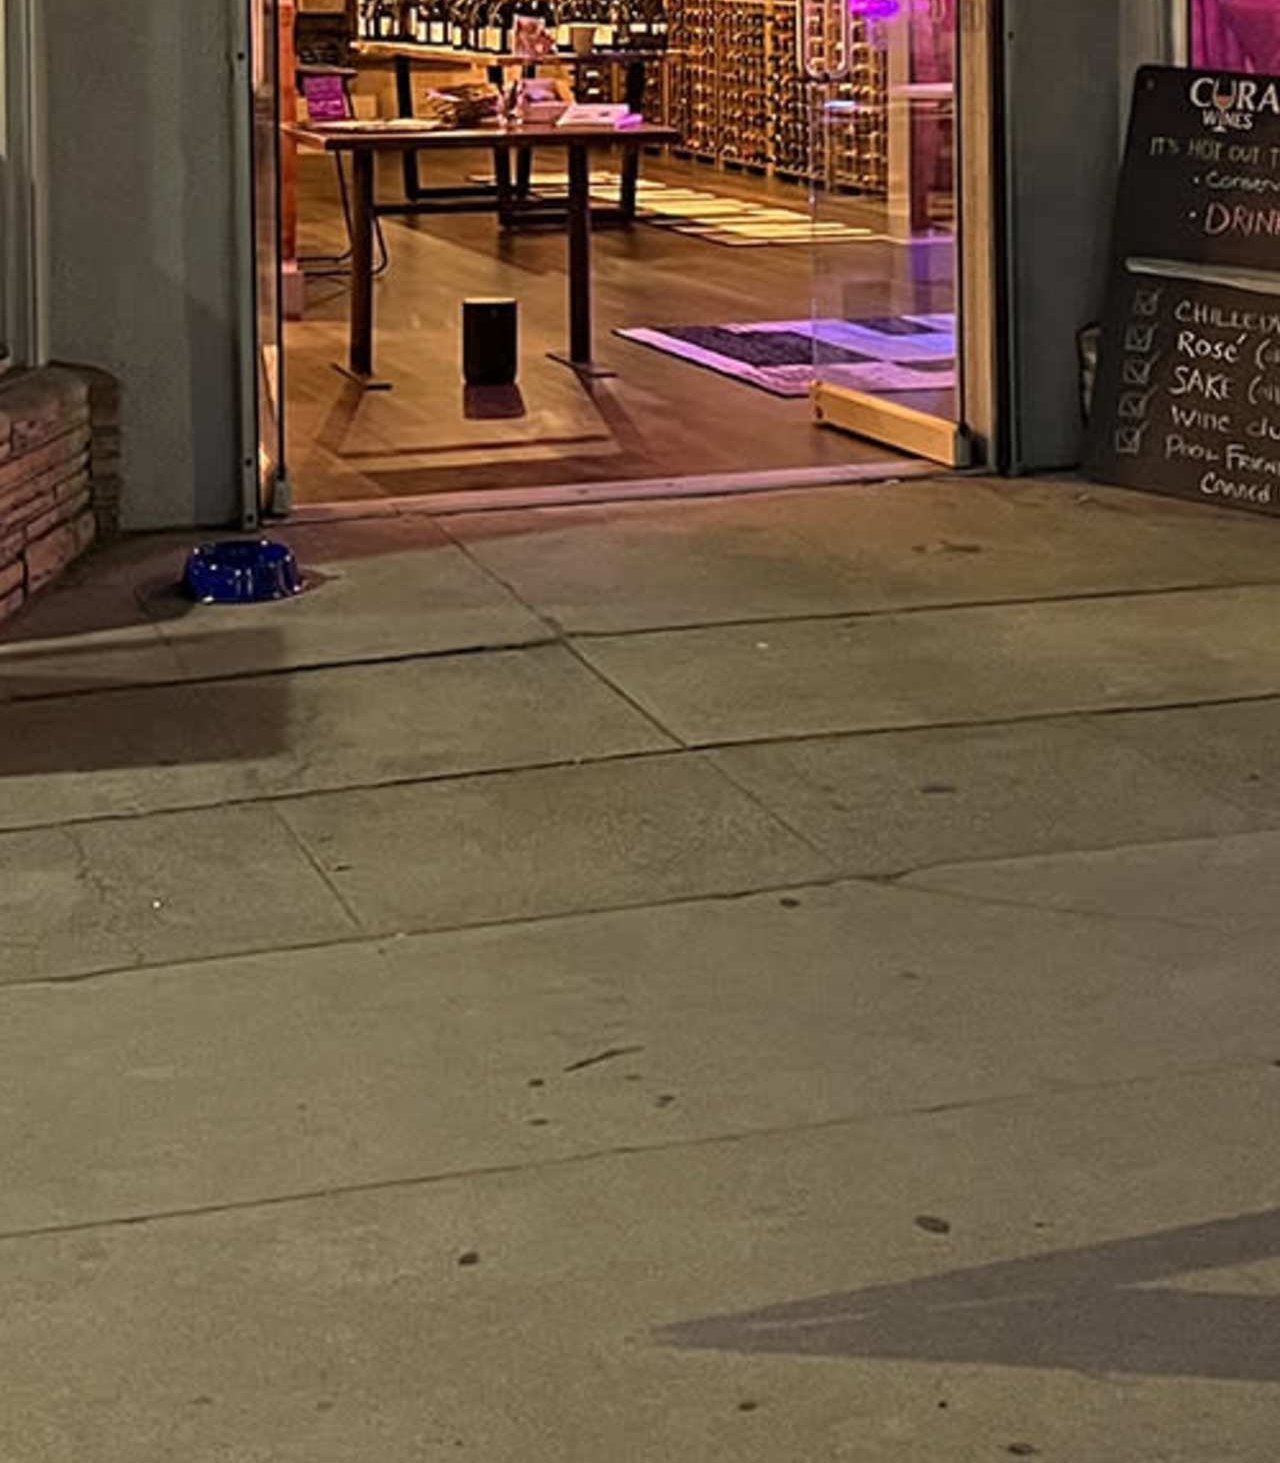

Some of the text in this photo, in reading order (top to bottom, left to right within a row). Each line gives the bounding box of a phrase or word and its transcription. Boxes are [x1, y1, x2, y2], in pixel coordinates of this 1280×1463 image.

[1201, 109, 1254, 133] WINES
[1188, 139, 1224, 161] HOT
[1228, 144, 1260, 166] OUT
[1169, 365, 1231, 400] SAKE
